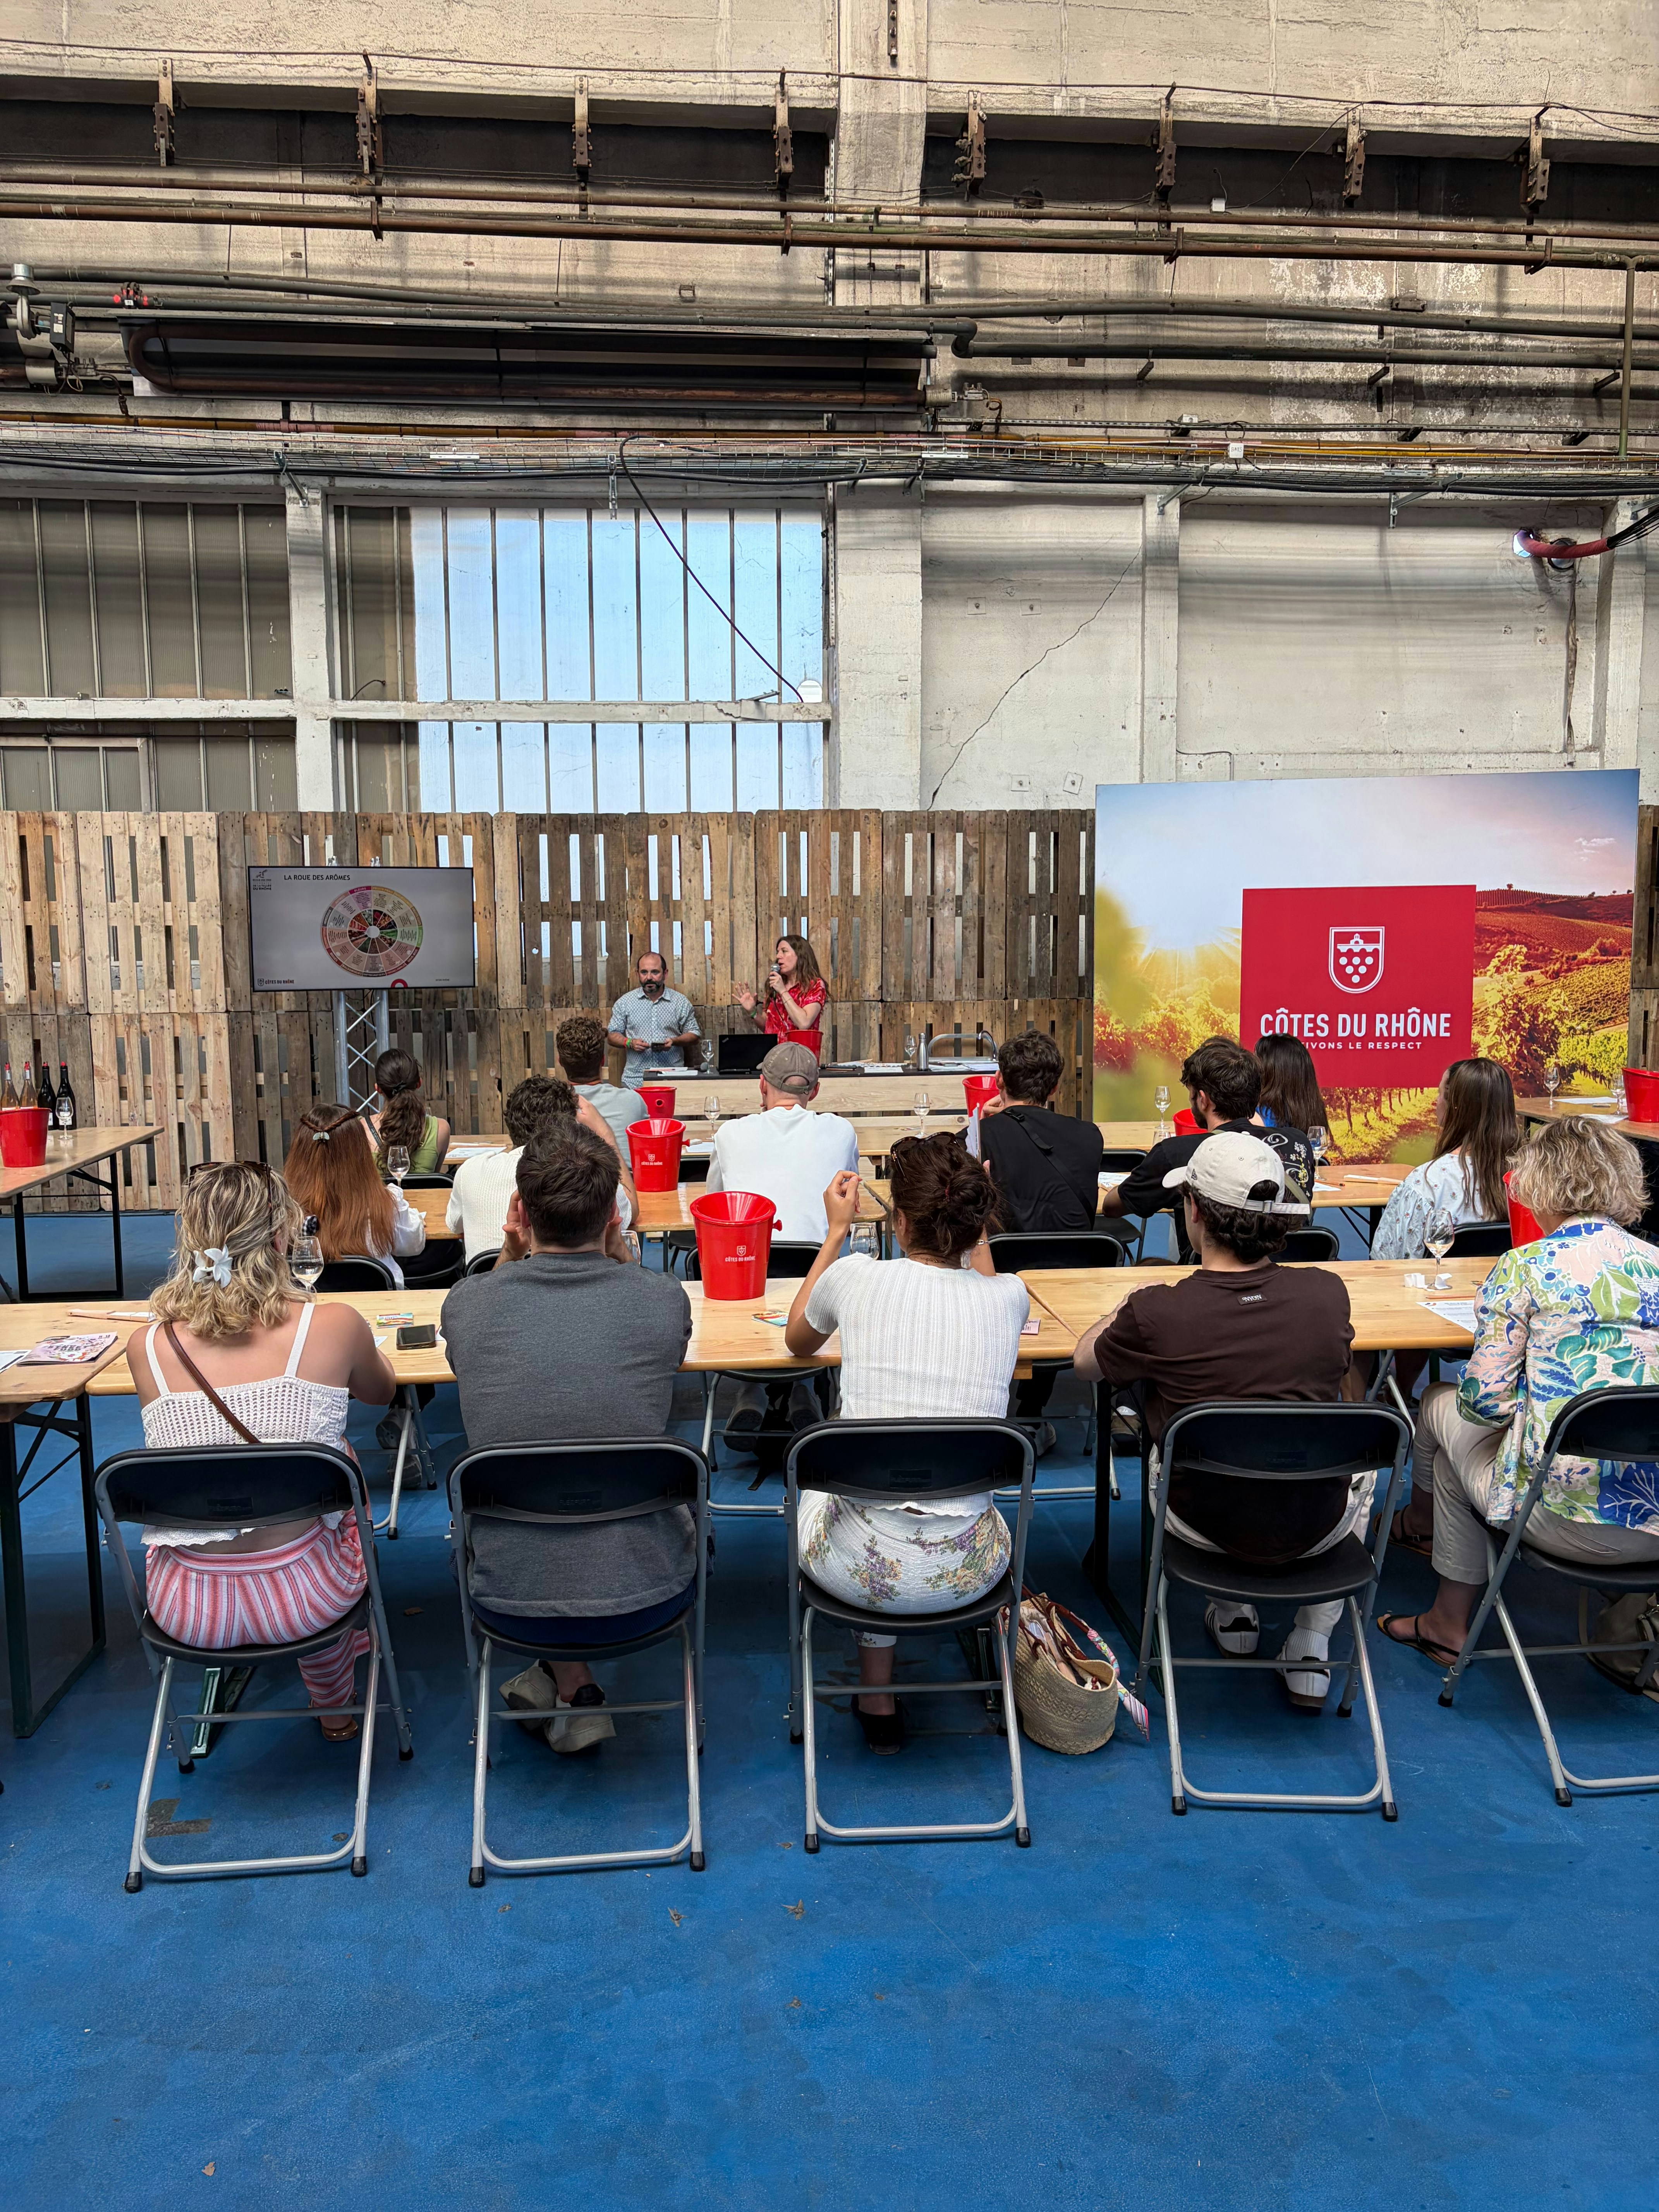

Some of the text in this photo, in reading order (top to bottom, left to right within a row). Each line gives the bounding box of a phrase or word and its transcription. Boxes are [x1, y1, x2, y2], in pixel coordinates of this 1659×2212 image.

[1260, 1007, 1451, 1037] CÔTES DU RHÔNE
